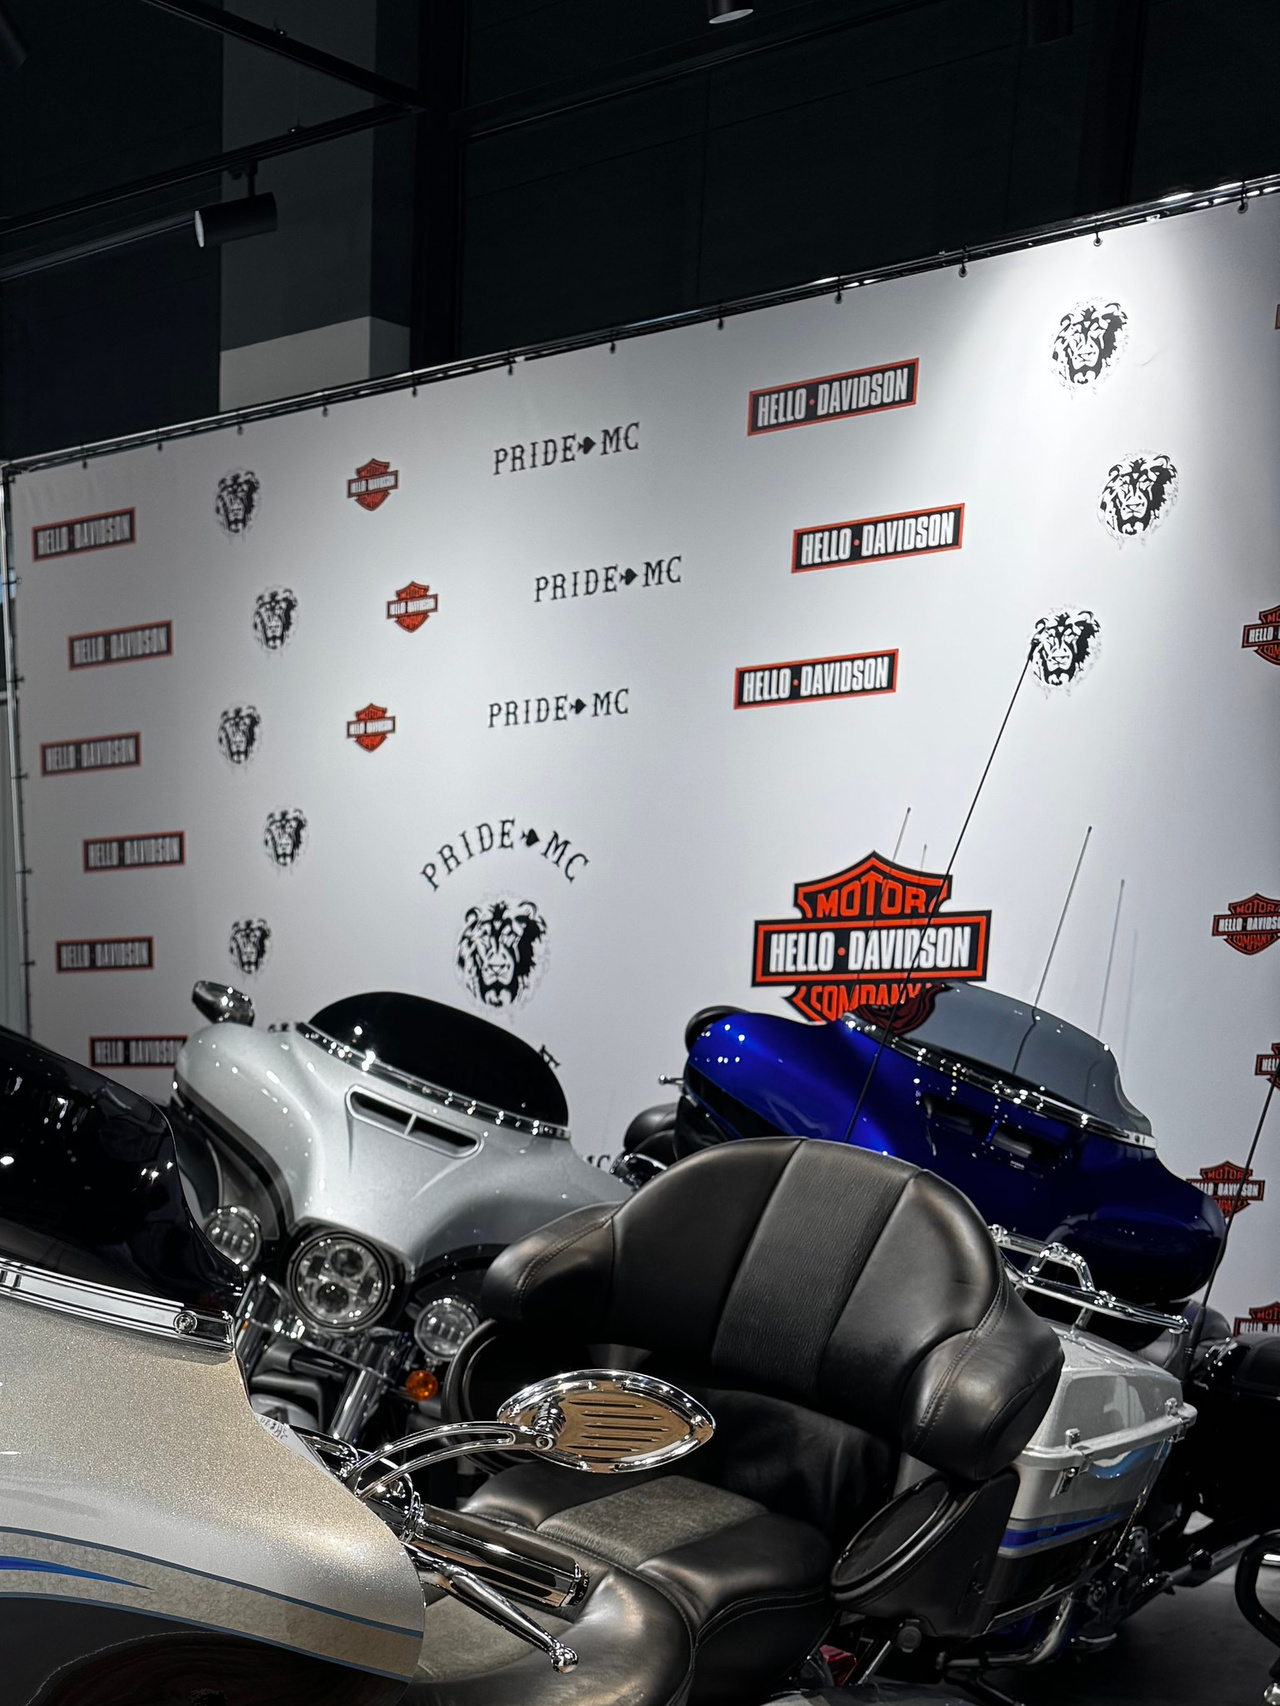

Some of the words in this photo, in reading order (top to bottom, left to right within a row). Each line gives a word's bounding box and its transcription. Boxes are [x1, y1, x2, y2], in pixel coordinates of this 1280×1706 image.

[757, 388, 807, 427] HELLO
[817, 368, 909, 416] DAVIDSON
[493, 433, 576, 476] PRIDE
[600, 421, 640, 456] MC
[800, 527, 852, 566] HELLO
[861, 511, 955, 557] DAVIDSON
[534, 564, 619, 603] PRIDE
[642, 555, 682, 588] MC
[1248, 626, 1274, 643] HELLO
[742, 668, 792, 703] HELLO
[800, 656, 890, 697] DAVIDSON
[488, 693, 569, 728] PRIDE
[591, 688, 629, 718] MC
[420, 816, 517, 893] PRIDE
[540, 830, 591, 884] MC
[816, 870, 927, 918] MOTOR
[1236, 900, 1275, 914] MOTOR
[769, 931, 836, 973] HELLO
[848, 925, 972, 972] DAVIDSON
